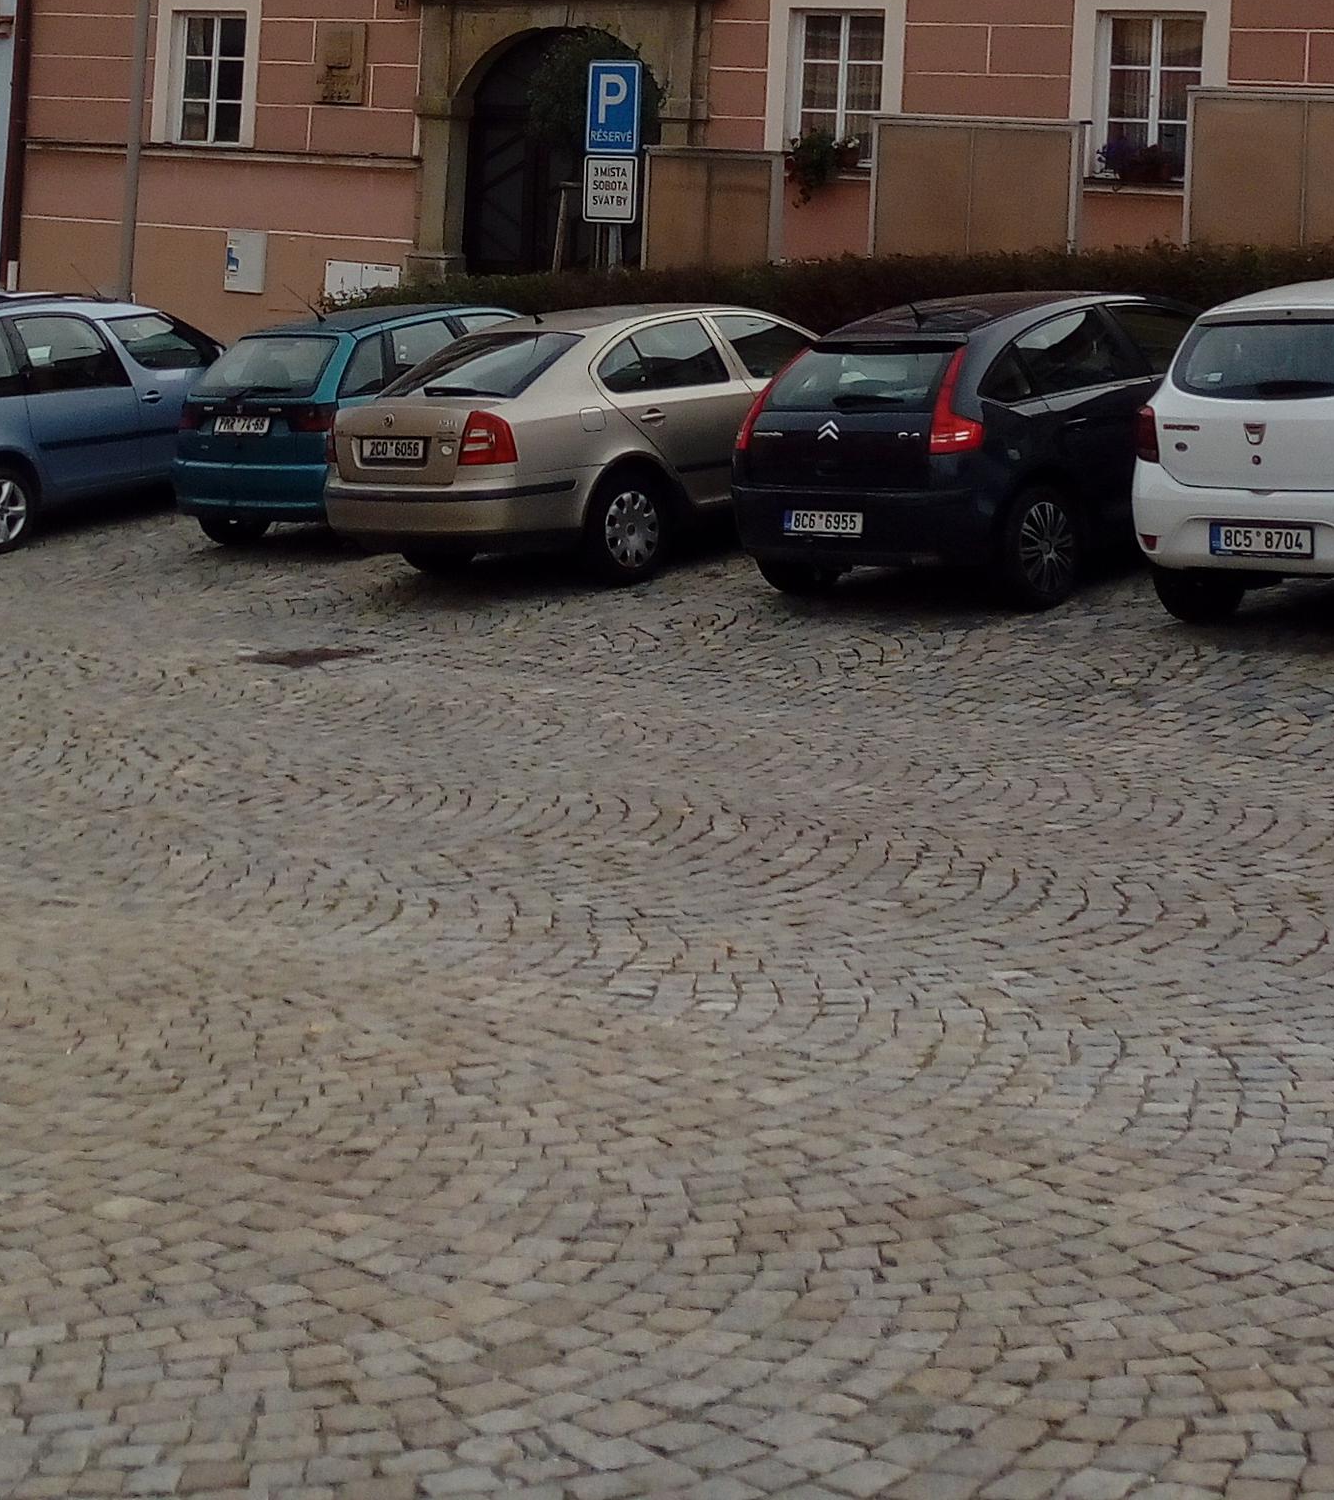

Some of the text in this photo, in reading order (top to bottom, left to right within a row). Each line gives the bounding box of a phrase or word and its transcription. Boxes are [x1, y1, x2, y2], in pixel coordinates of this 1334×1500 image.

[598, 74, 628, 124] P
[593, 180, 629, 192] SOBOTA
[395, 442, 419, 457] 6056
[794, 513, 816, 529] 8C6
[824, 514, 857, 530] 6955
[1224, 529, 1303, 550] 8C5 8704
